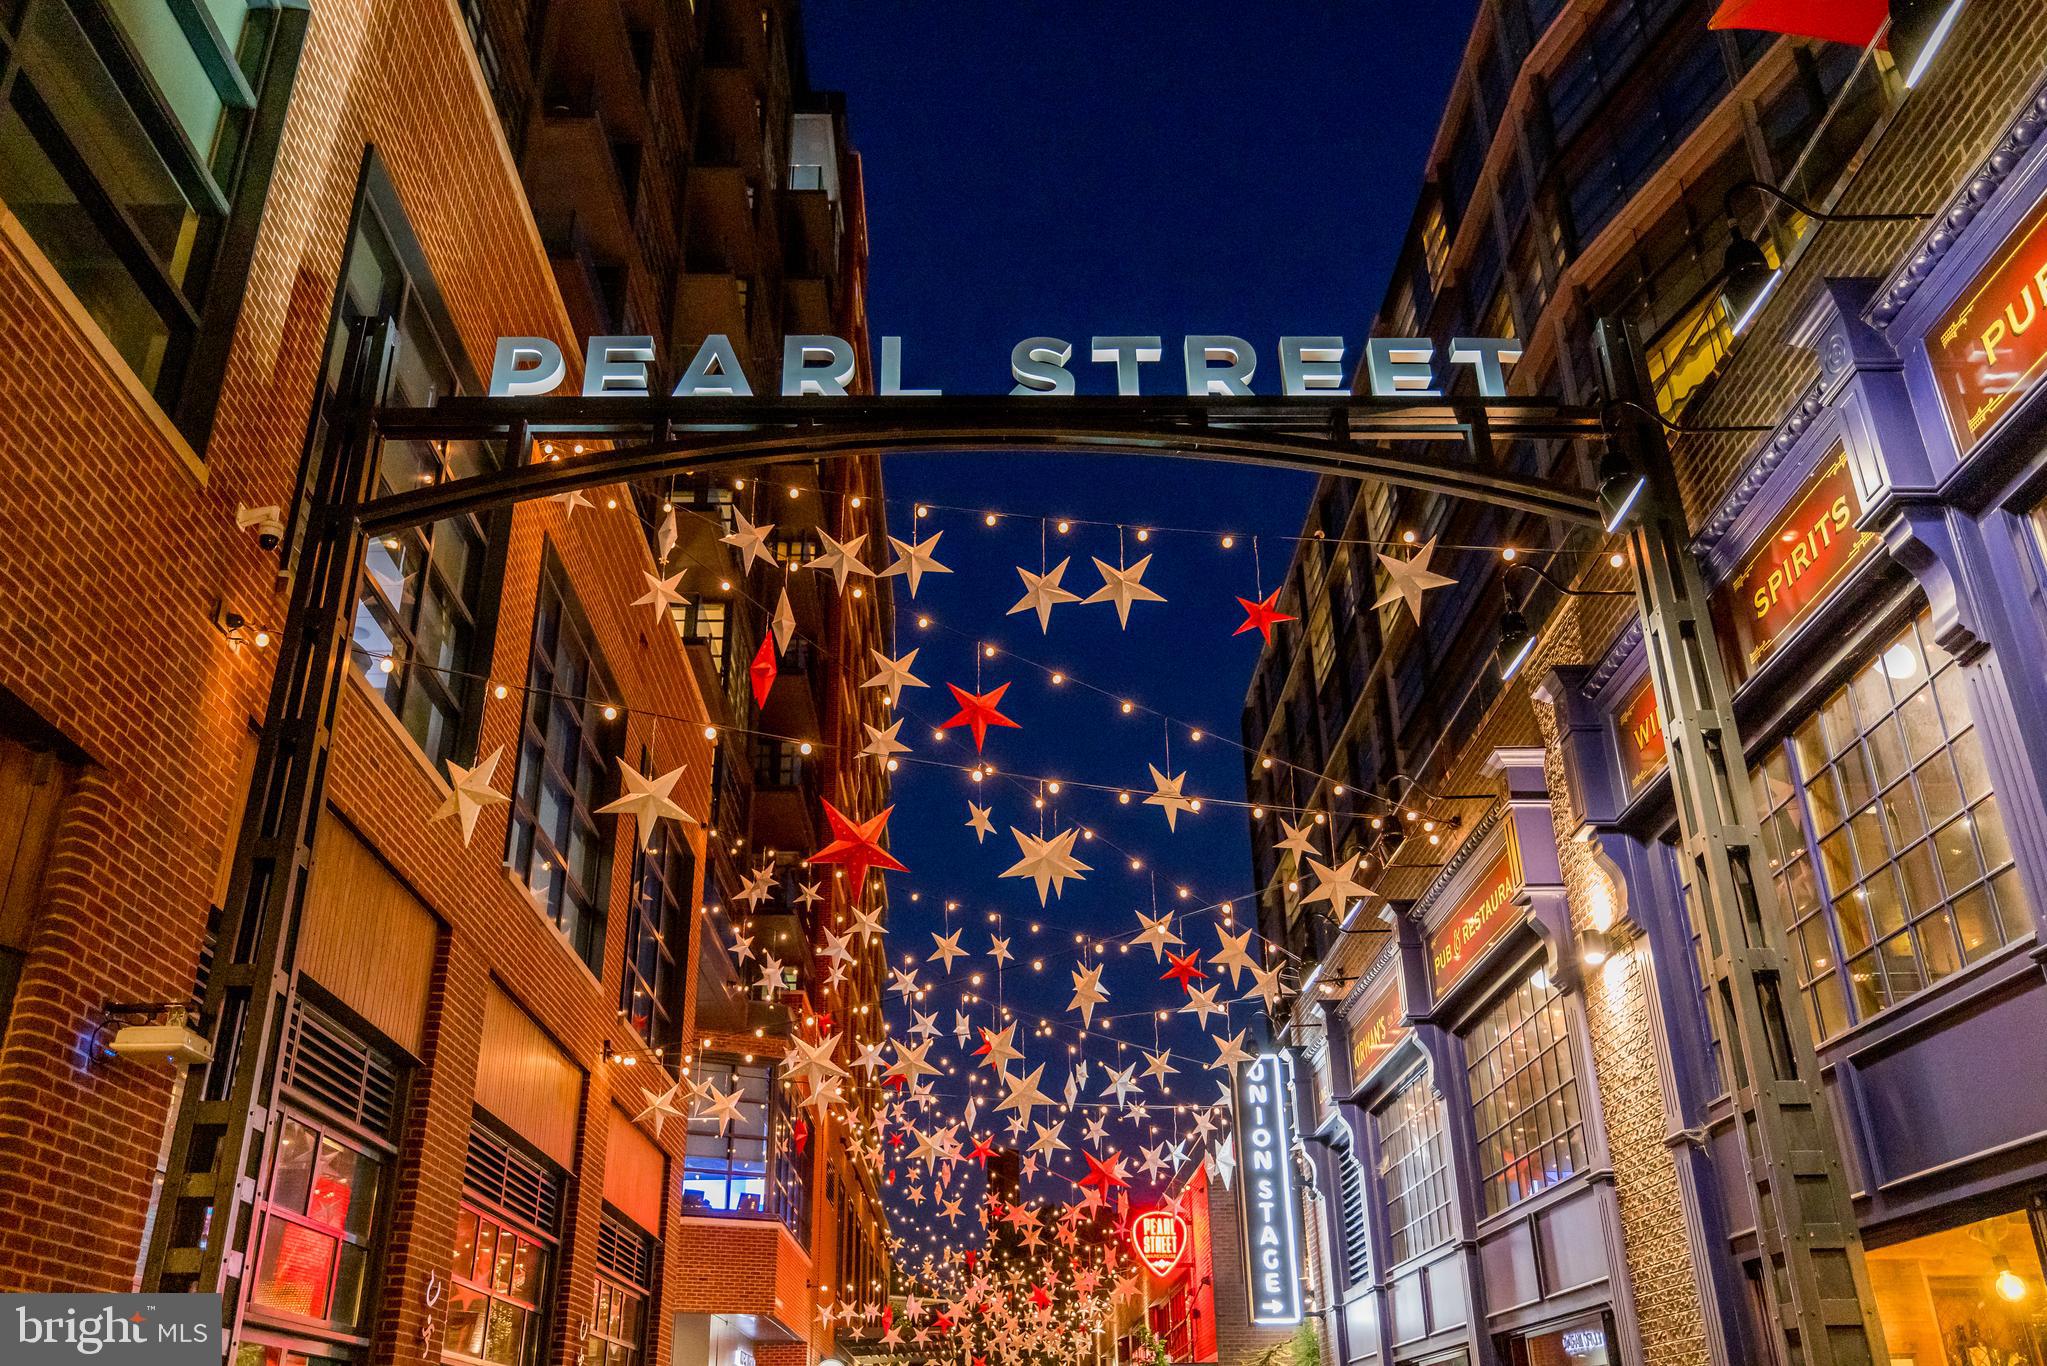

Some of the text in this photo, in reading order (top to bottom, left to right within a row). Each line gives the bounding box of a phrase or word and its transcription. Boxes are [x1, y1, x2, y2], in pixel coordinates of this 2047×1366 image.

[489, 334, 1523, 397] PEARL STREET
[1754, 494, 1850, 619] SPIRITS
[1634, 706, 1662, 750] WI
[1434, 943, 1452, 976] PUB
[1462, 876, 1513, 944] RESTAURA
[1354, 1015, 1386, 1069] KIRWAN'S
[1249, 1063, 1283, 1294] UNION STAGE
[1143, 1218, 1176, 1235] PEARL
[1143, 1235, 1177, 1253] STREET
